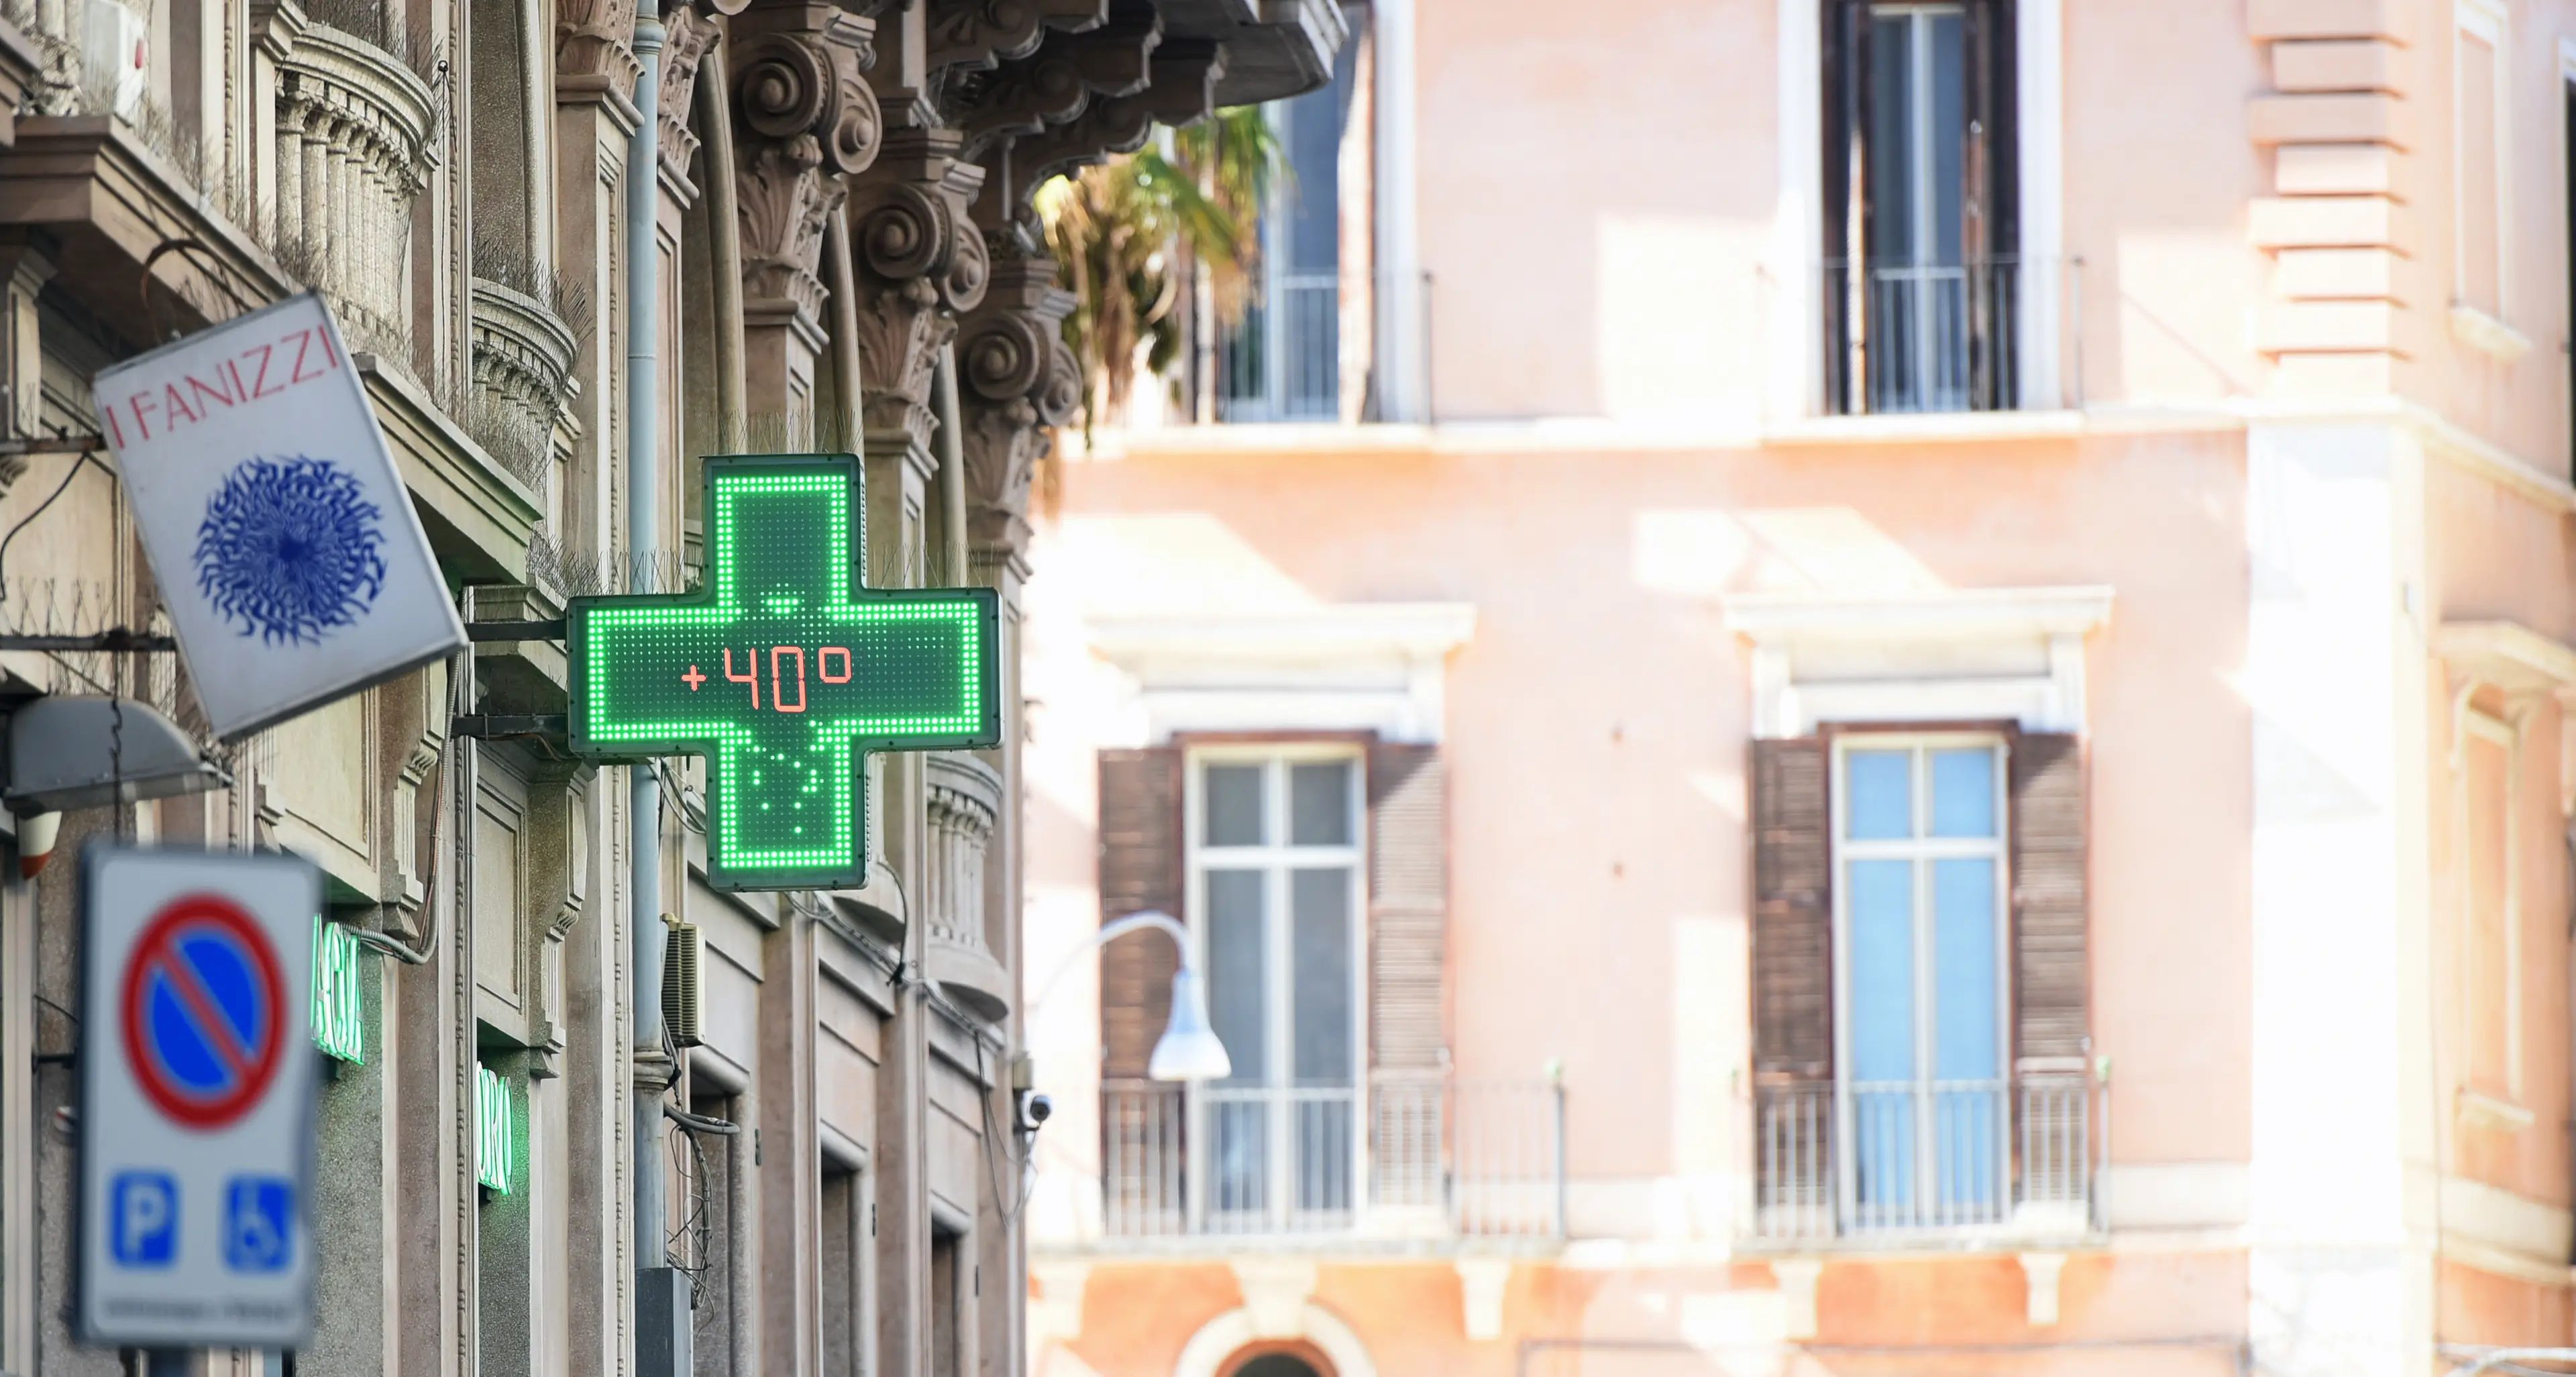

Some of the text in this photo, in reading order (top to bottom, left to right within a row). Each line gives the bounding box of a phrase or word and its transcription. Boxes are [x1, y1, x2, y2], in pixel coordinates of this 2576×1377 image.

[129, 325, 337, 440] FANIZZI
[311, 913, 365, 1064] ACIA
[125, 1182, 168, 1255] P
